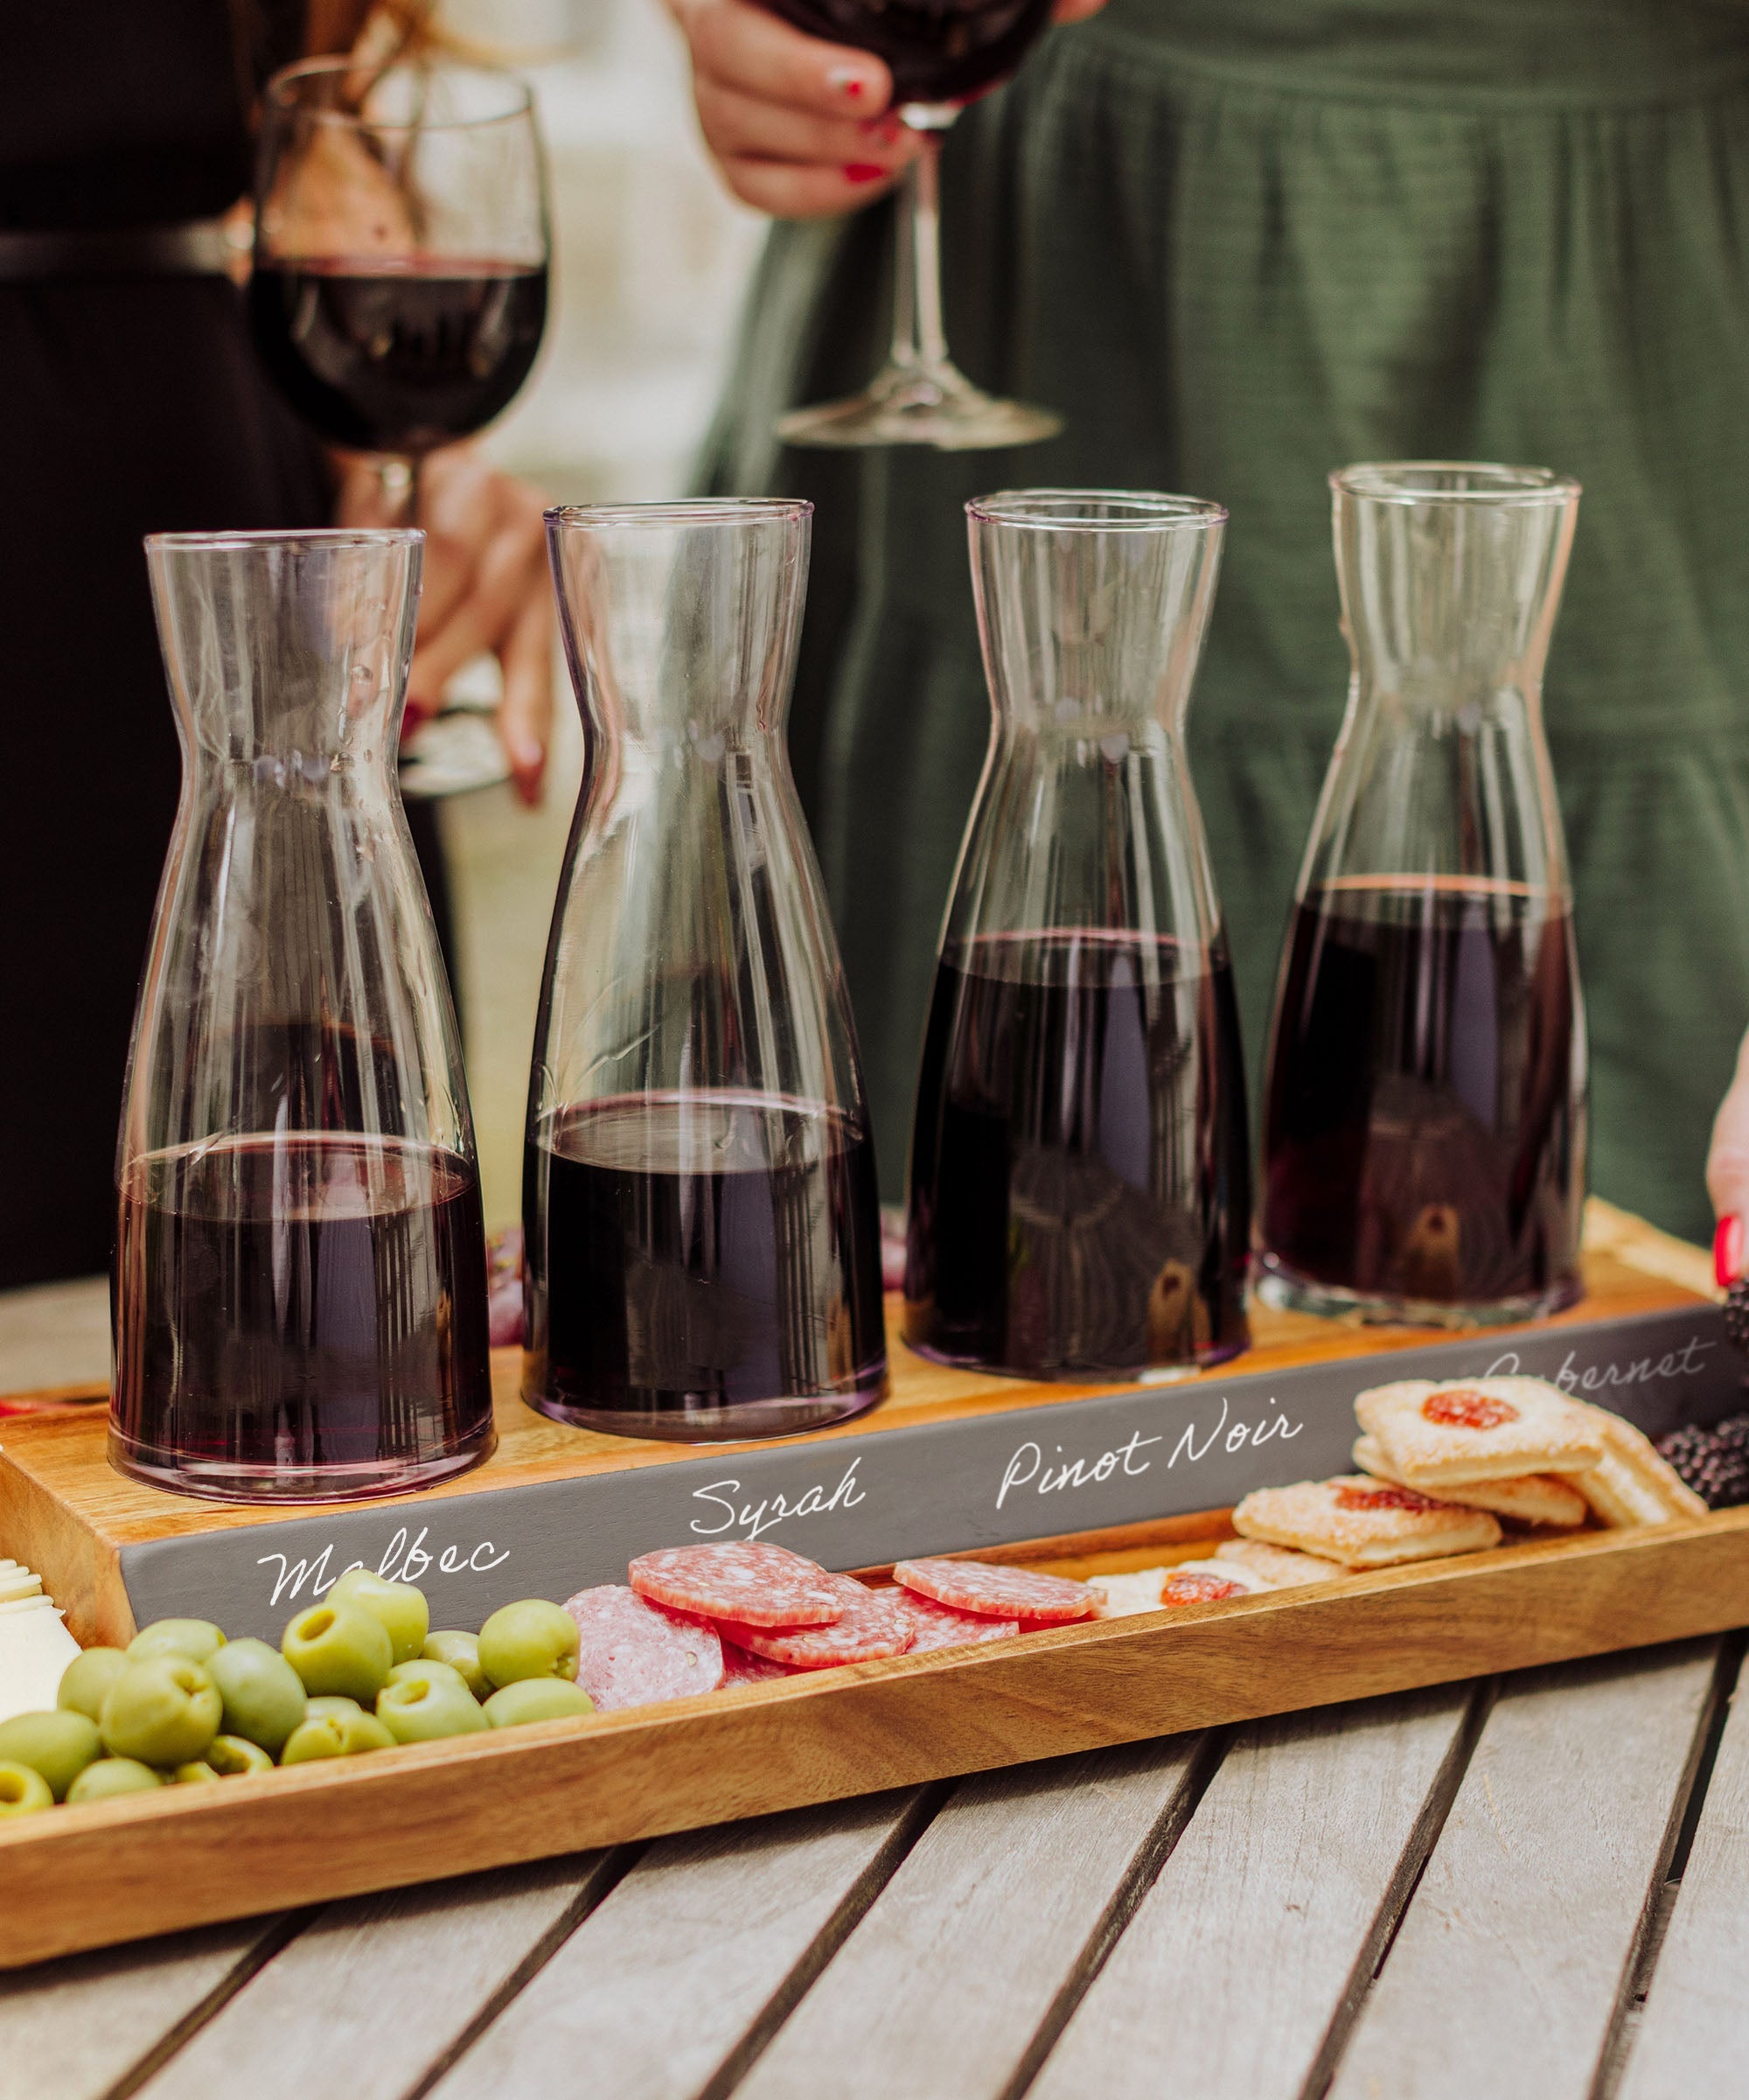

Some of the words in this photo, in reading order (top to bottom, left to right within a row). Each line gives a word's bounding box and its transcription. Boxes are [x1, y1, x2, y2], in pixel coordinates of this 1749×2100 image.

[1483, 1336, 1717, 1392] bernet
[996, 1430, 1162, 1510] Pinot
[1167, 1397, 1304, 1469] Noir
[690, 1456, 867, 1542] Syrah
